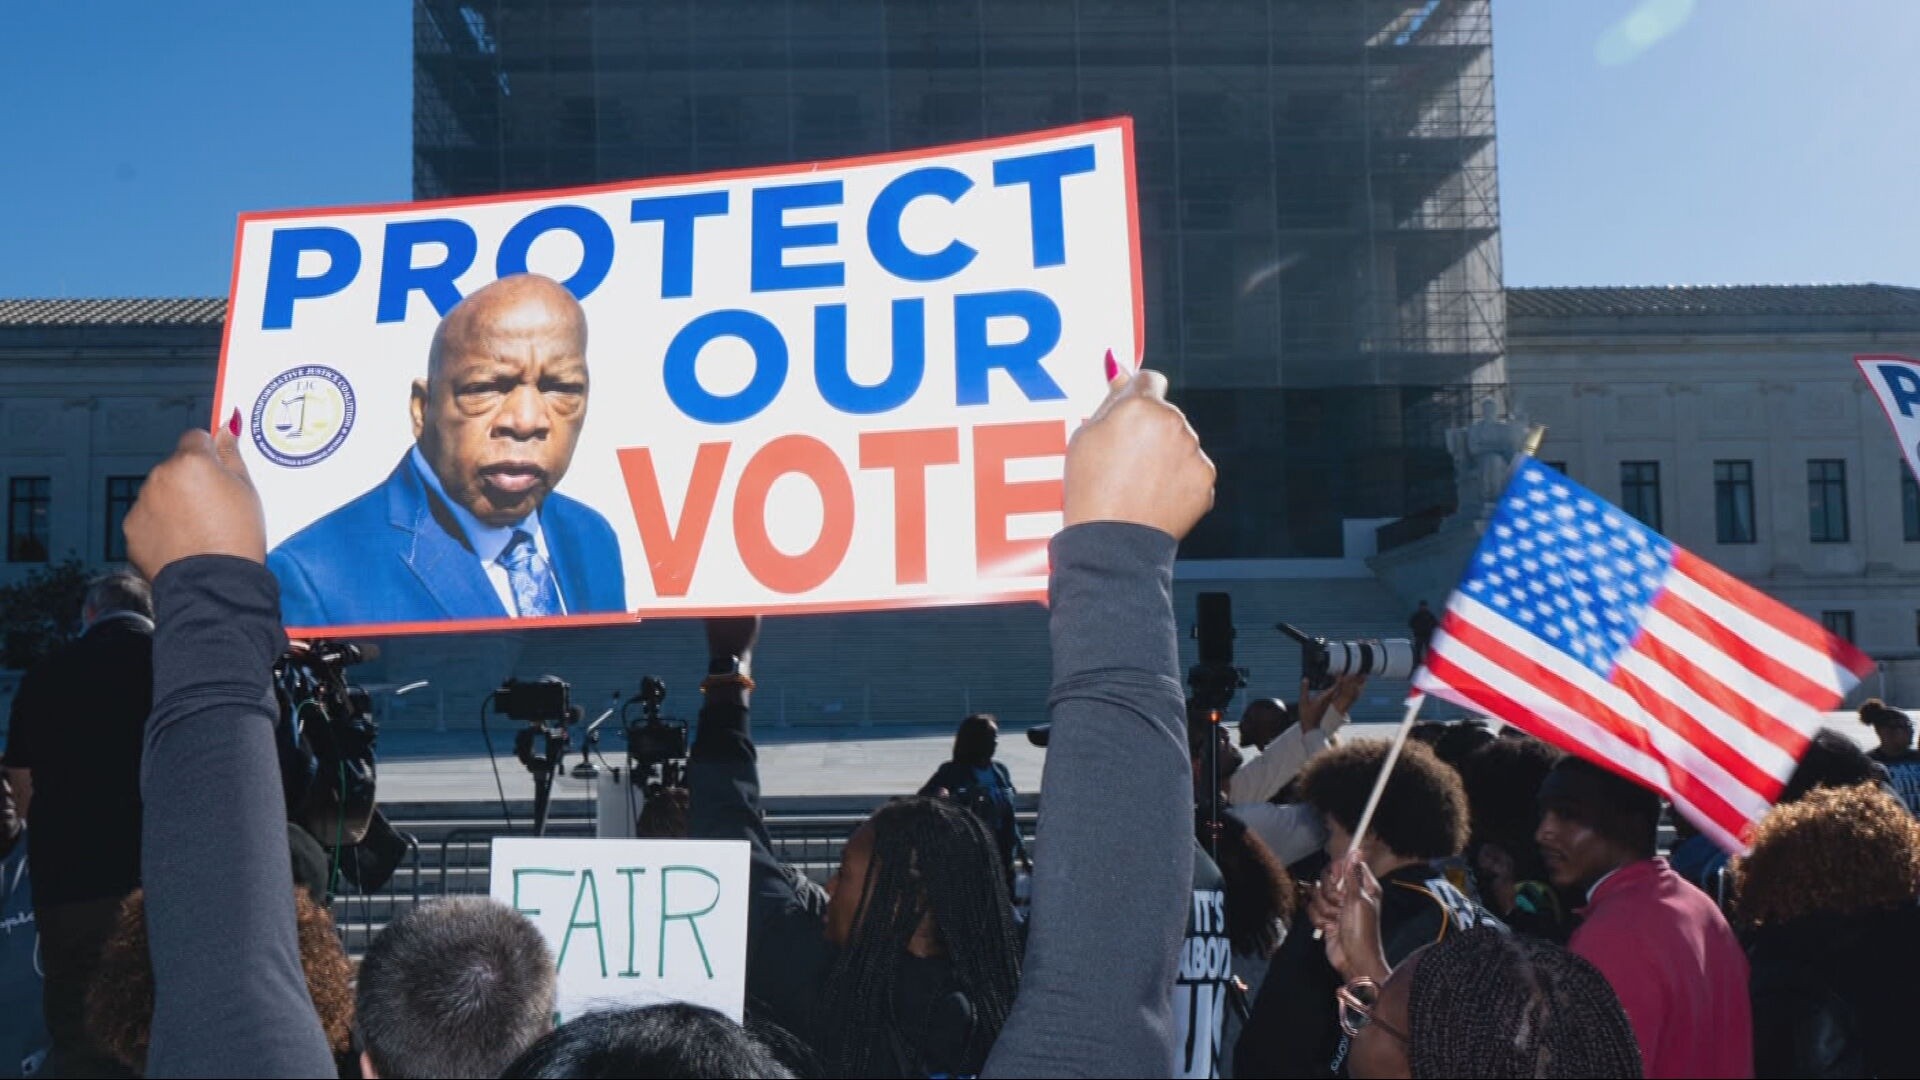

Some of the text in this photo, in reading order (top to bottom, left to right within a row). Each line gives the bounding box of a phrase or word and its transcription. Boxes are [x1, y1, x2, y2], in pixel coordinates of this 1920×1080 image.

[262, 144, 1096, 330] PROTECT
[663, 289, 1065, 424] OUR
[617, 420, 1072, 597] VOTE
[512, 865, 721, 979] FAIR
[1193, 889, 1225, 933] IT'S
